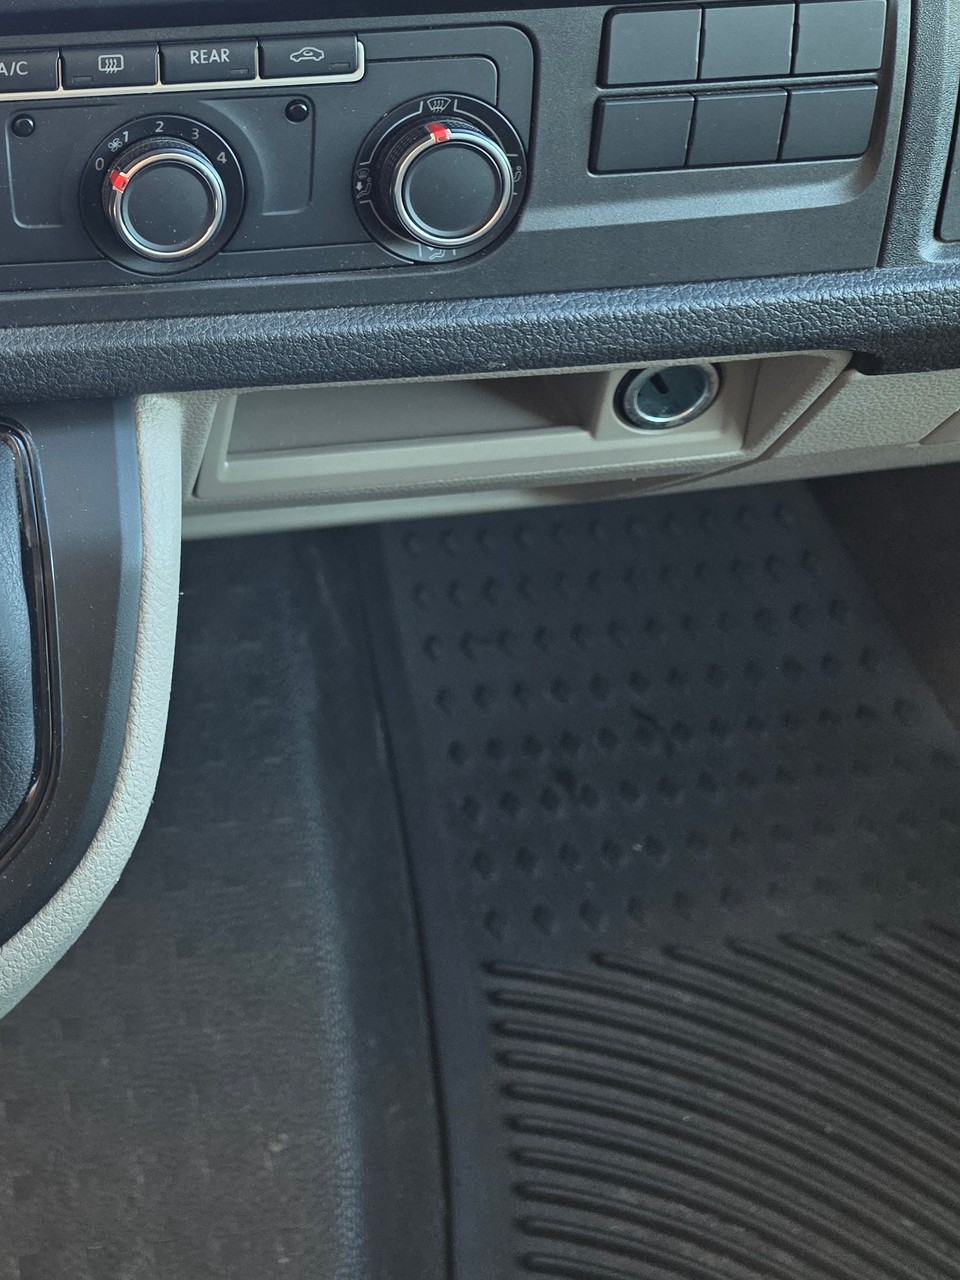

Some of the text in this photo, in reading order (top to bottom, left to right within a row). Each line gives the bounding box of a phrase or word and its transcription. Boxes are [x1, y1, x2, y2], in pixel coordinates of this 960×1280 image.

[190, 48, 230, 65] REAR
[155, 121, 164, 133] 2
[122, 131, 129, 143] 1
[191, 128, 200, 140] 3
[94, 157, 105, 171] 0
[216, 152, 227, 164] 4
